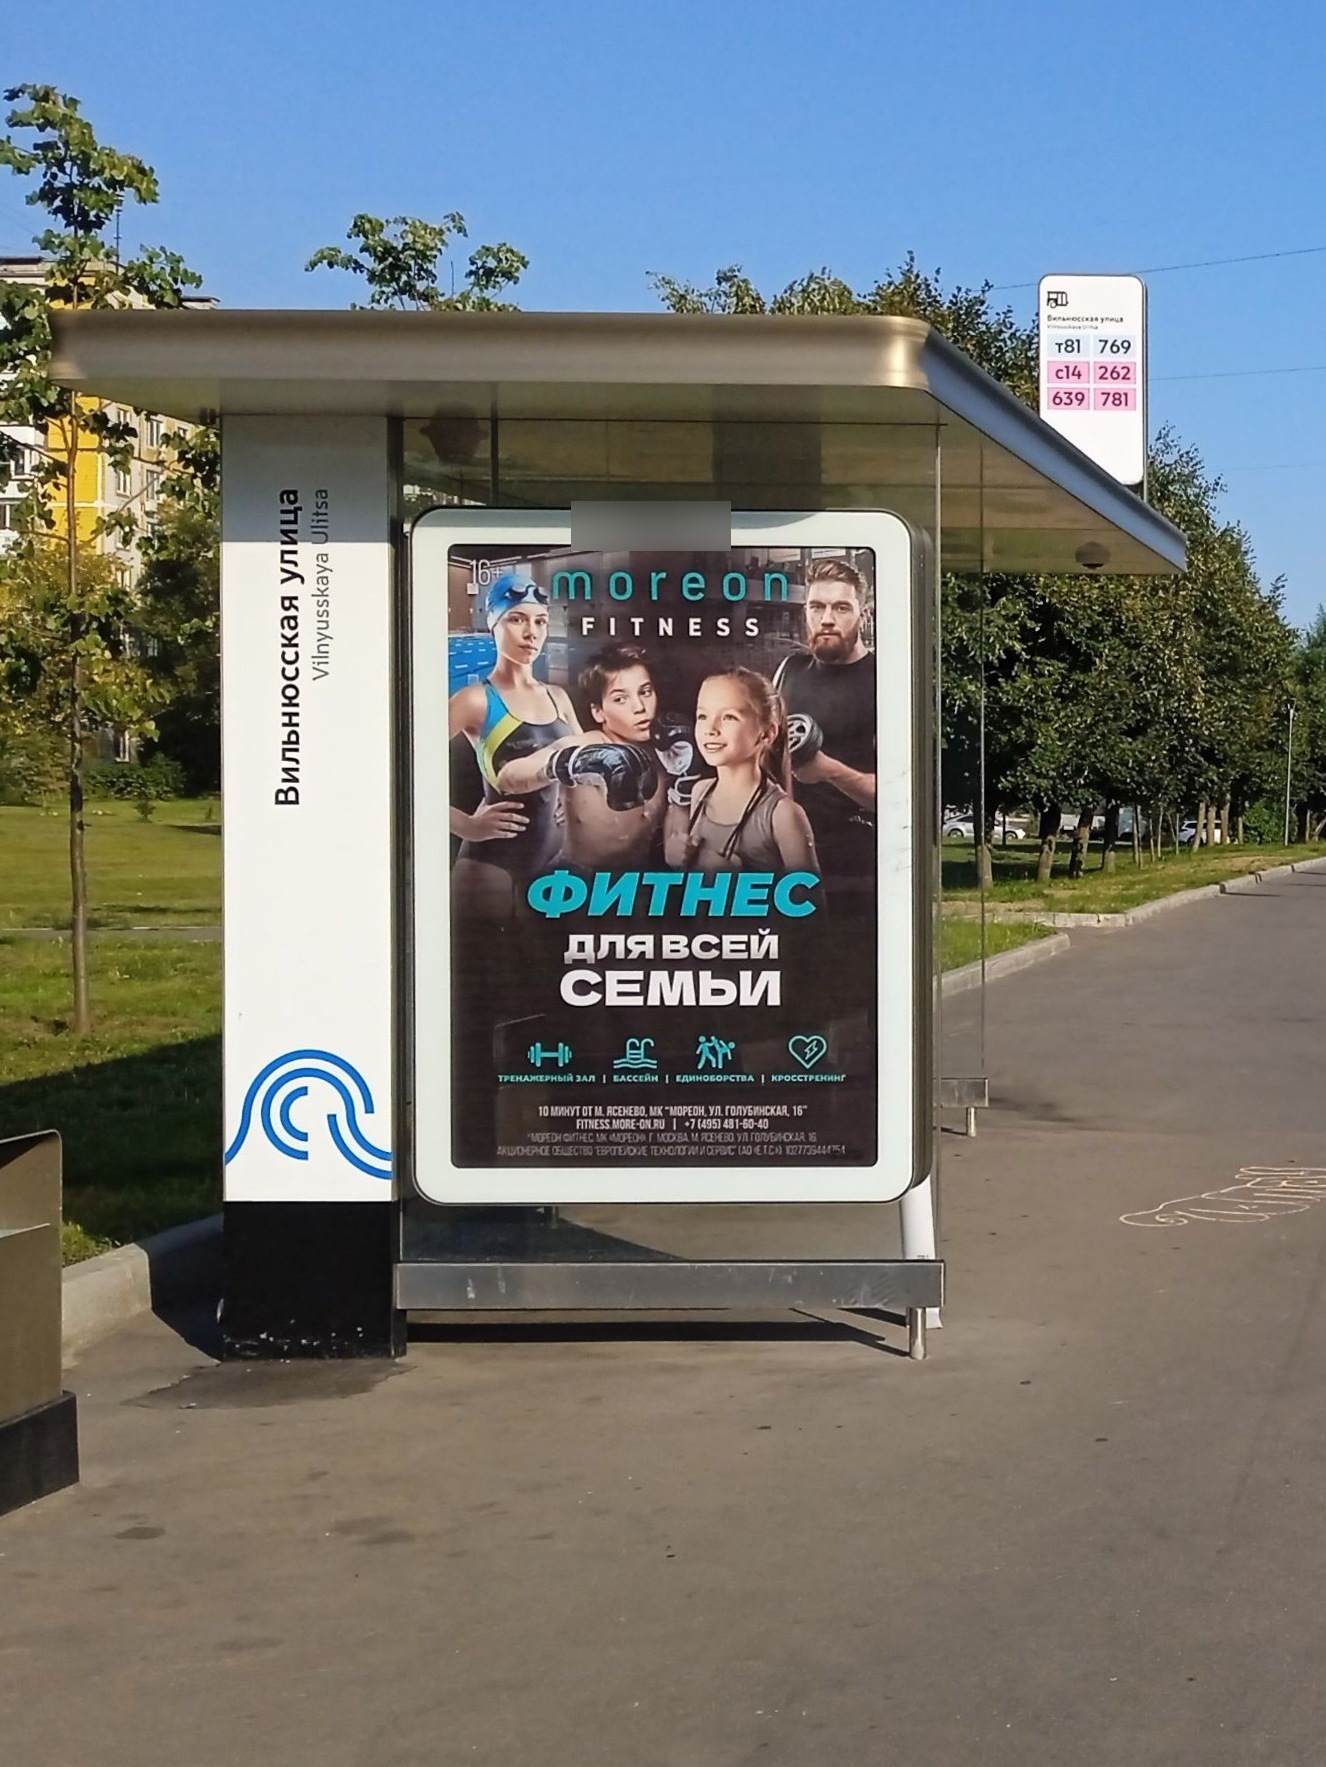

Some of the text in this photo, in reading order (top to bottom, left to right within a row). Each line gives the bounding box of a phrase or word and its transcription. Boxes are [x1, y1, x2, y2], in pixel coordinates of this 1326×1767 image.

[1055, 339, 1131, 354] т81 769
[1098, 365, 1131, 380] 262
[1052, 391, 1128, 407] 639 781
[469, 558, 504, 586] 16+
[310, 488, 333, 681] Vilnyusskaya Ulitsa
[552, 570, 789, 601] moreon
[582, 616, 760, 637] FITNESS
[275, 488, 305, 805] Вильнюсская улица
[527, 870, 820, 918] ФИТНЕС
[564, 928, 779, 964] ДЛЯ ВСЕЙ
[559, 969, 781, 1007] СЕМЬИ
[498, 1073, 596, 1083] ТРЕНАЖЕРНЫЙ ЗАЛ
[612, 1073, 659, 1083] БАССЕЙН
[675, 1074, 755, 1083] ЕДИНОБОРСТВА
[771, 1074, 847, 1083] КРОССТРЕНИНГ
[538, 1106, 549, 1116] 10
[550, 1106, 581, 1116] МИНУТ
[582, 1106, 593, 1116] ОТ
[594, 1106, 605, 1116] М.
[606, 1106, 648, 1118] ЯСЕНЕВО,
[649, 1106, 663, 1116] МК
[709, 1105, 724, 1116] УЛ.
[725, 1105, 790, 1117] ГОЛУБИНСКАЯ,
[576, 1119, 665, 1129] FITNESS.MORE-ON.RU
[684, 1118, 769, 1129] +7 (495) 481-60-40
